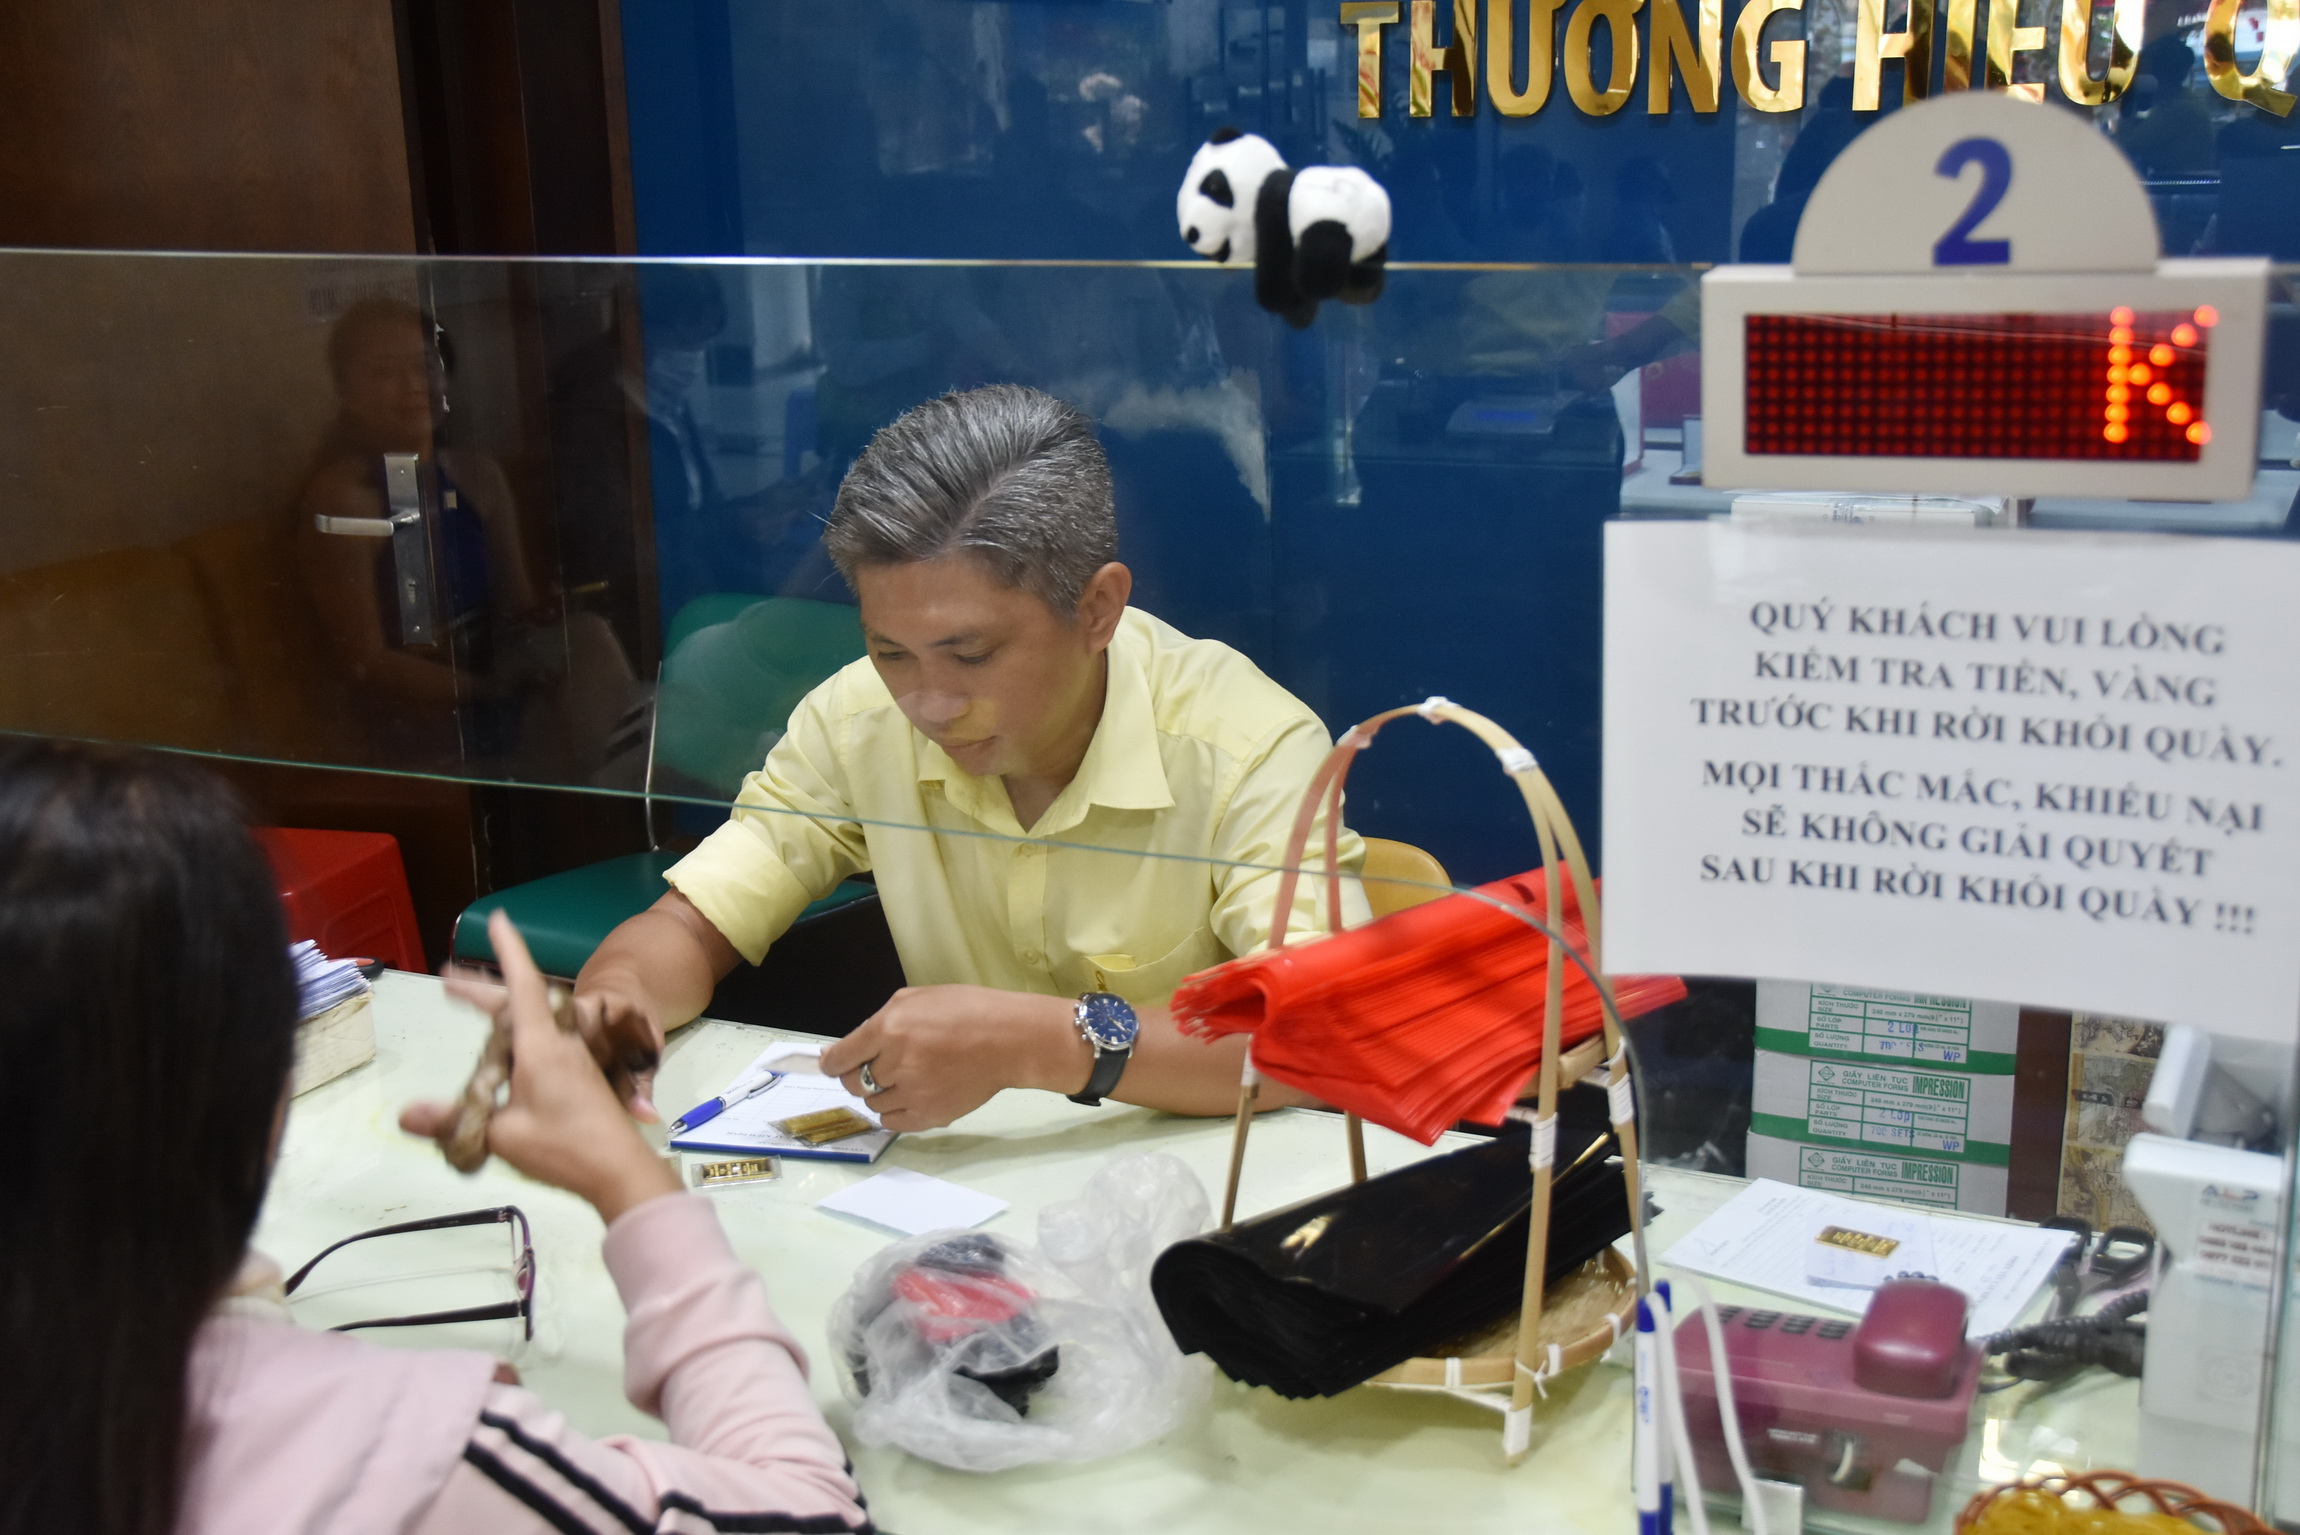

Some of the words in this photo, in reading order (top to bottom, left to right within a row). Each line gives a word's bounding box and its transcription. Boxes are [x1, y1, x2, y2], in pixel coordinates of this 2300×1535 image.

[1933, 137, 2012, 265] 2
[2103, 305, 2219, 444] K
[1750, 596, 1835, 636] QUÝ
[1849, 601, 1996, 640] KHÁCH
[2013, 614, 2085, 645] VUI
[2101, 612, 2224, 654] LÒNG
[1872, 657, 1954, 688] TRA
[2094, 664, 2216, 706] VÀNG
[1691, 693, 1833, 731] TRƯỚC
[1845, 706, 1917, 737] KHI
[1933, 705, 2005, 743] RỜI
[2021, 714, 2132, 750] KHỎI
[1703, 760, 1781, 794] MỌI
[1792, 760, 1904, 797] THẮC
[2187, 797, 2263, 836] NẠI
[1742, 804, 1787, 836] SẼ
[1801, 810, 1949, 850] KHÔNG
[1960, 822, 2050, 859] GIẢI
[1701, 854, 1775, 883] SAU
[1789, 860, 1860, 890] KHI
[1873, 862, 1944, 897] RỜI
[1959, 874, 2065, 911] KHỎI
[2215, 903, 2255, 935] !!!
[1814, 1041, 1848, 1049] QUANTITY
[1943, 1050, 1961, 1062] WP
[1842, 1078, 1881, 1088] COMPUTER
[1883, 1083, 1909, 1092] FORMS
[1867, 1073, 1886, 1082] LIÊN
[1912, 1076, 1965, 1099] IMPRESSION
[1812, 1127, 1846, 1136] QUANTITY
[1891, 1128, 1915, 1139] SETS
[1942, 1140, 1960, 1151] WP
[1831, 1164, 1871, 1174] COMPUTER
[1872, 1168, 1898, 1178] FORMS
[1856, 1159, 1875, 1168] LIÊN
[1901, 1161, 1954, 1185] IMPRESSION
